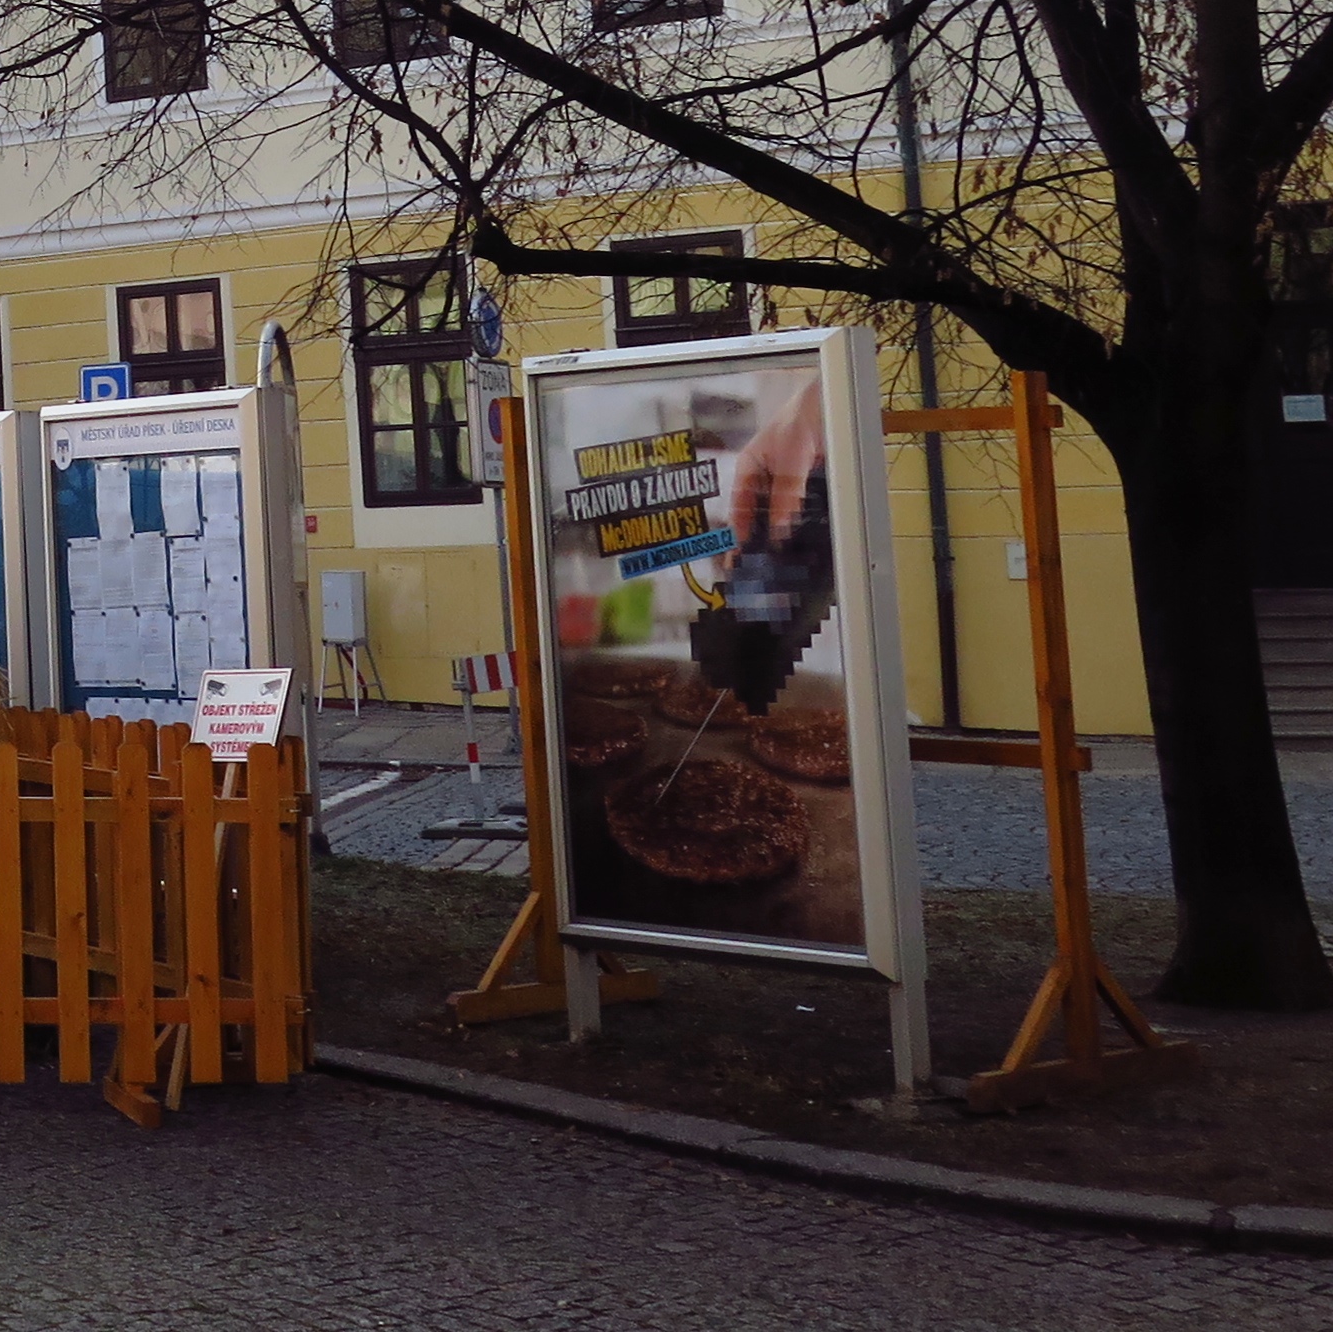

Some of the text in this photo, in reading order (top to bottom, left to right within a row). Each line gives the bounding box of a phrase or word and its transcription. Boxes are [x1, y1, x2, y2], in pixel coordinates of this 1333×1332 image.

[90, 376, 119, 401] P
[207, 418, 236, 432] DESKA
[579, 432, 692, 479] ODHALILI JSME
[571, 482, 628, 521] PRAVDU
[630, 479, 641, 509] O
[202, 704, 237, 716] OBJEKT
[209, 719, 265, 735] KAMEROVÝM
[211, 738, 256, 753] SYSTÉME
